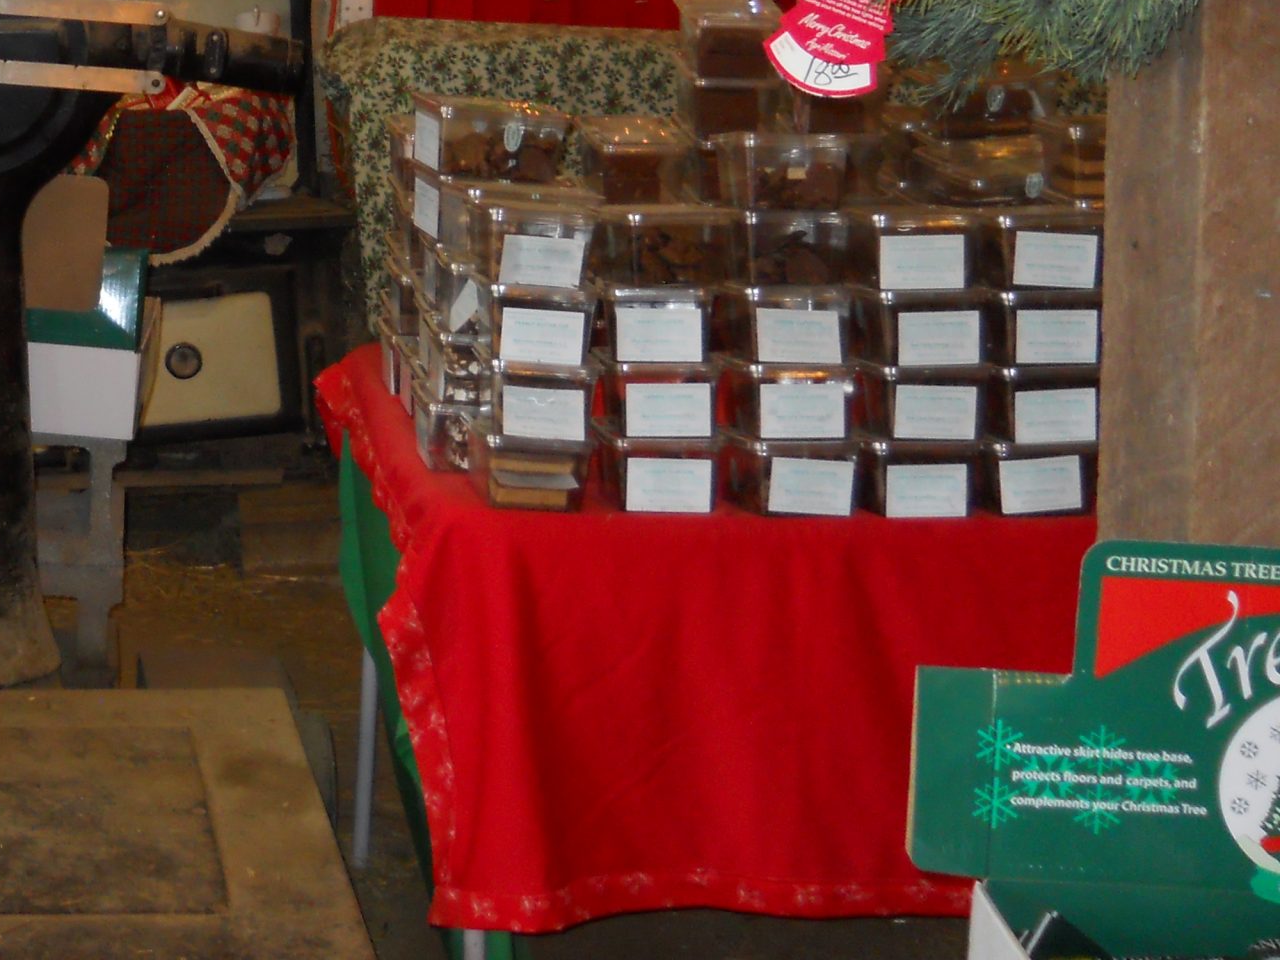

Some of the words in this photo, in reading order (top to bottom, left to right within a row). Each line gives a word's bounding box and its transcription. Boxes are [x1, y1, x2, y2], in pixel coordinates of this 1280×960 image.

[828, 23, 871, 50] Christmas
[1106, 555, 1227, 577] CHRISTMAS
[1013, 742, 1071, 758] Attractive
[1073, 745, 1100, 759] skirt
[1103, 746, 1134, 761] hides
[1136, 749, 1160, 762] tree
[1012, 769, 1061, 785] protects
[1063, 771, 1097, 785] floors
[1099, 773, 1122, 786] and
[1126, 775, 1172, 790] carpets,
[1174, 777, 1197, 790] and
[1010, 794, 1090, 812] complements
[1091, 800, 1120, 814] your
[1121, 800, 1180, 815] Christmas
[1182, 803, 1208, 817] Tree
